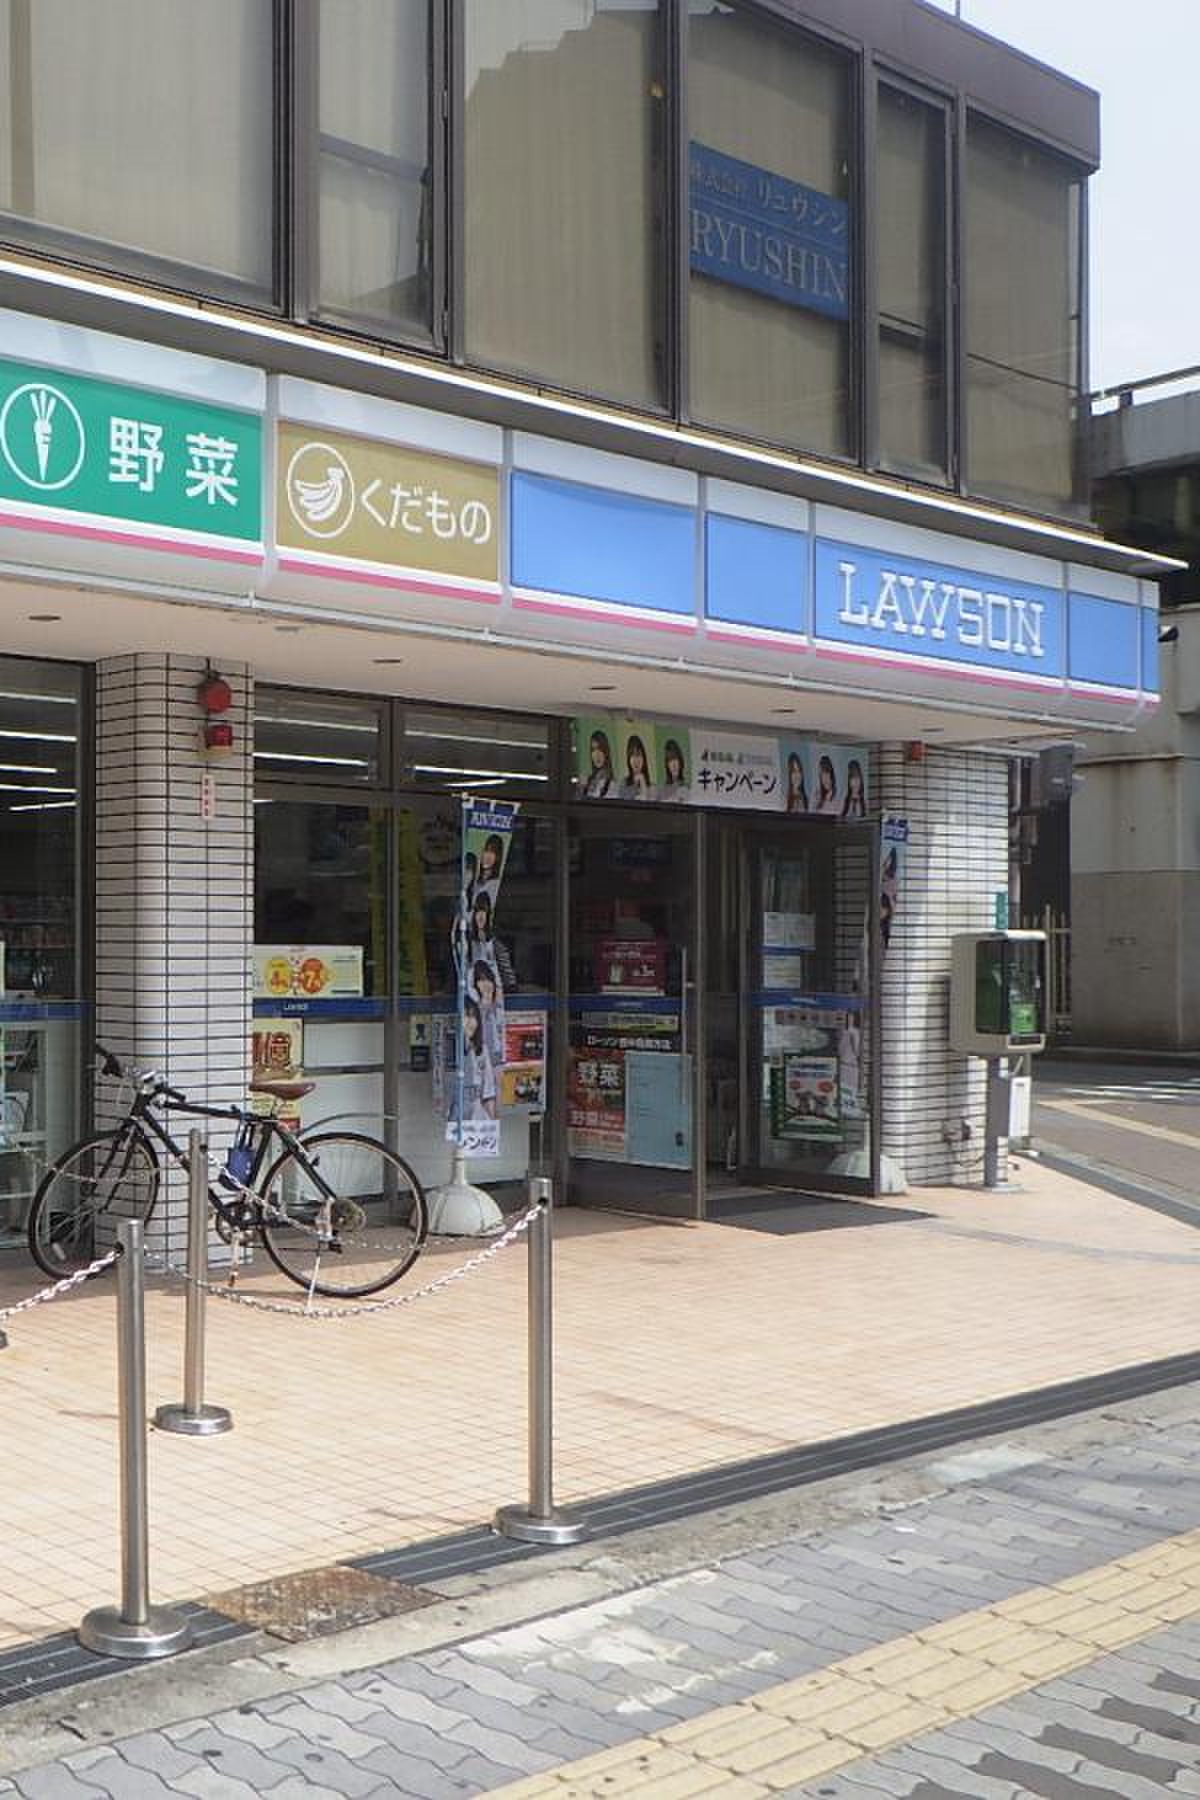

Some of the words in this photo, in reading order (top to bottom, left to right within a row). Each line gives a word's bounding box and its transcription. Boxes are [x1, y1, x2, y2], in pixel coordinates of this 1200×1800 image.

[689, 208, 847, 303] RYUSHIN
[109, 416, 239, 506] 野菜
[361, 479, 492, 544] くだもの
[839, 562, 1045, 657] LAWSON
[698, 768, 777, 794] キャンペーン
